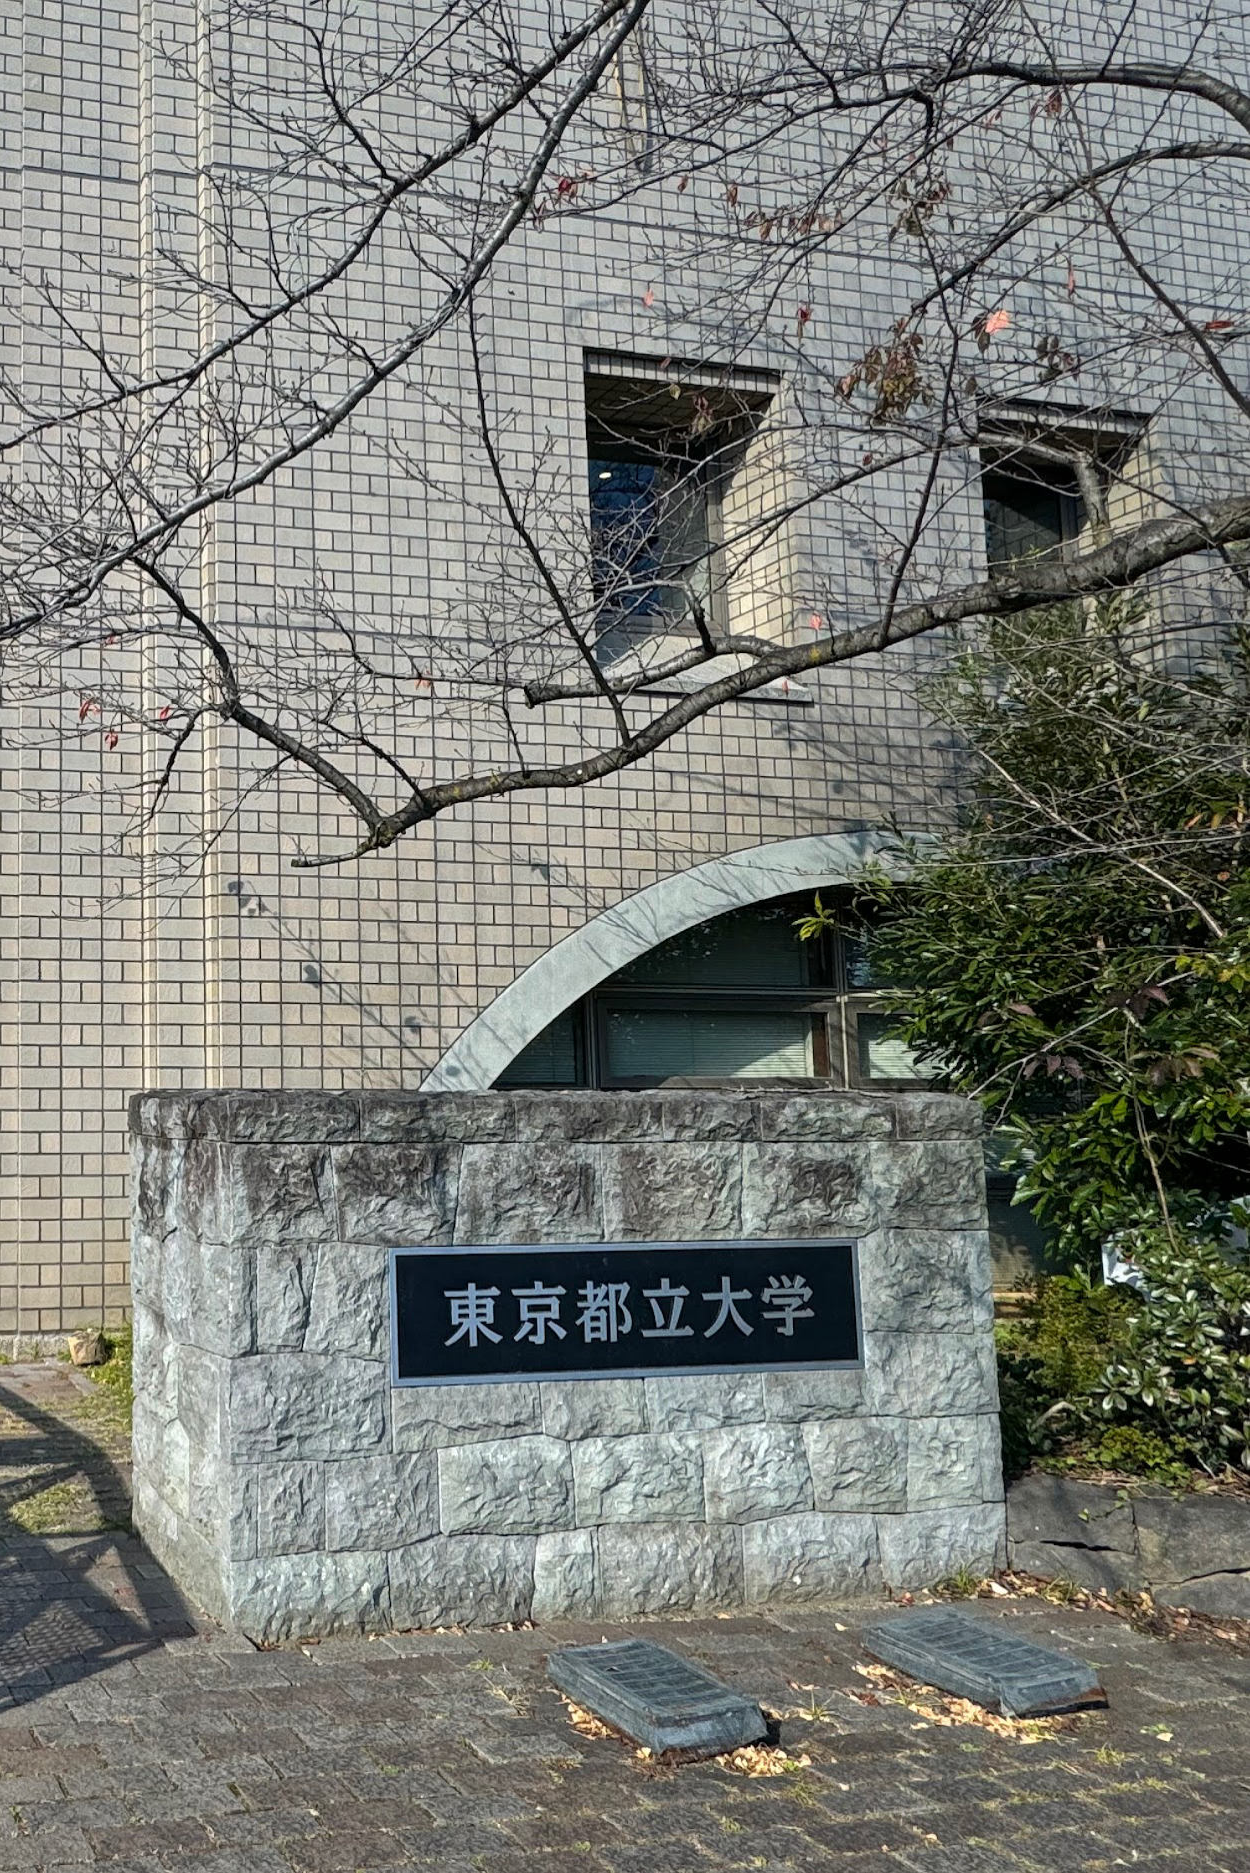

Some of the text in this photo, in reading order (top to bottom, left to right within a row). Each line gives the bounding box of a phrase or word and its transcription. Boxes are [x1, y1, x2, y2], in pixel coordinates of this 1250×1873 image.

[443, 1274, 816, 1348] 東京都立大学
